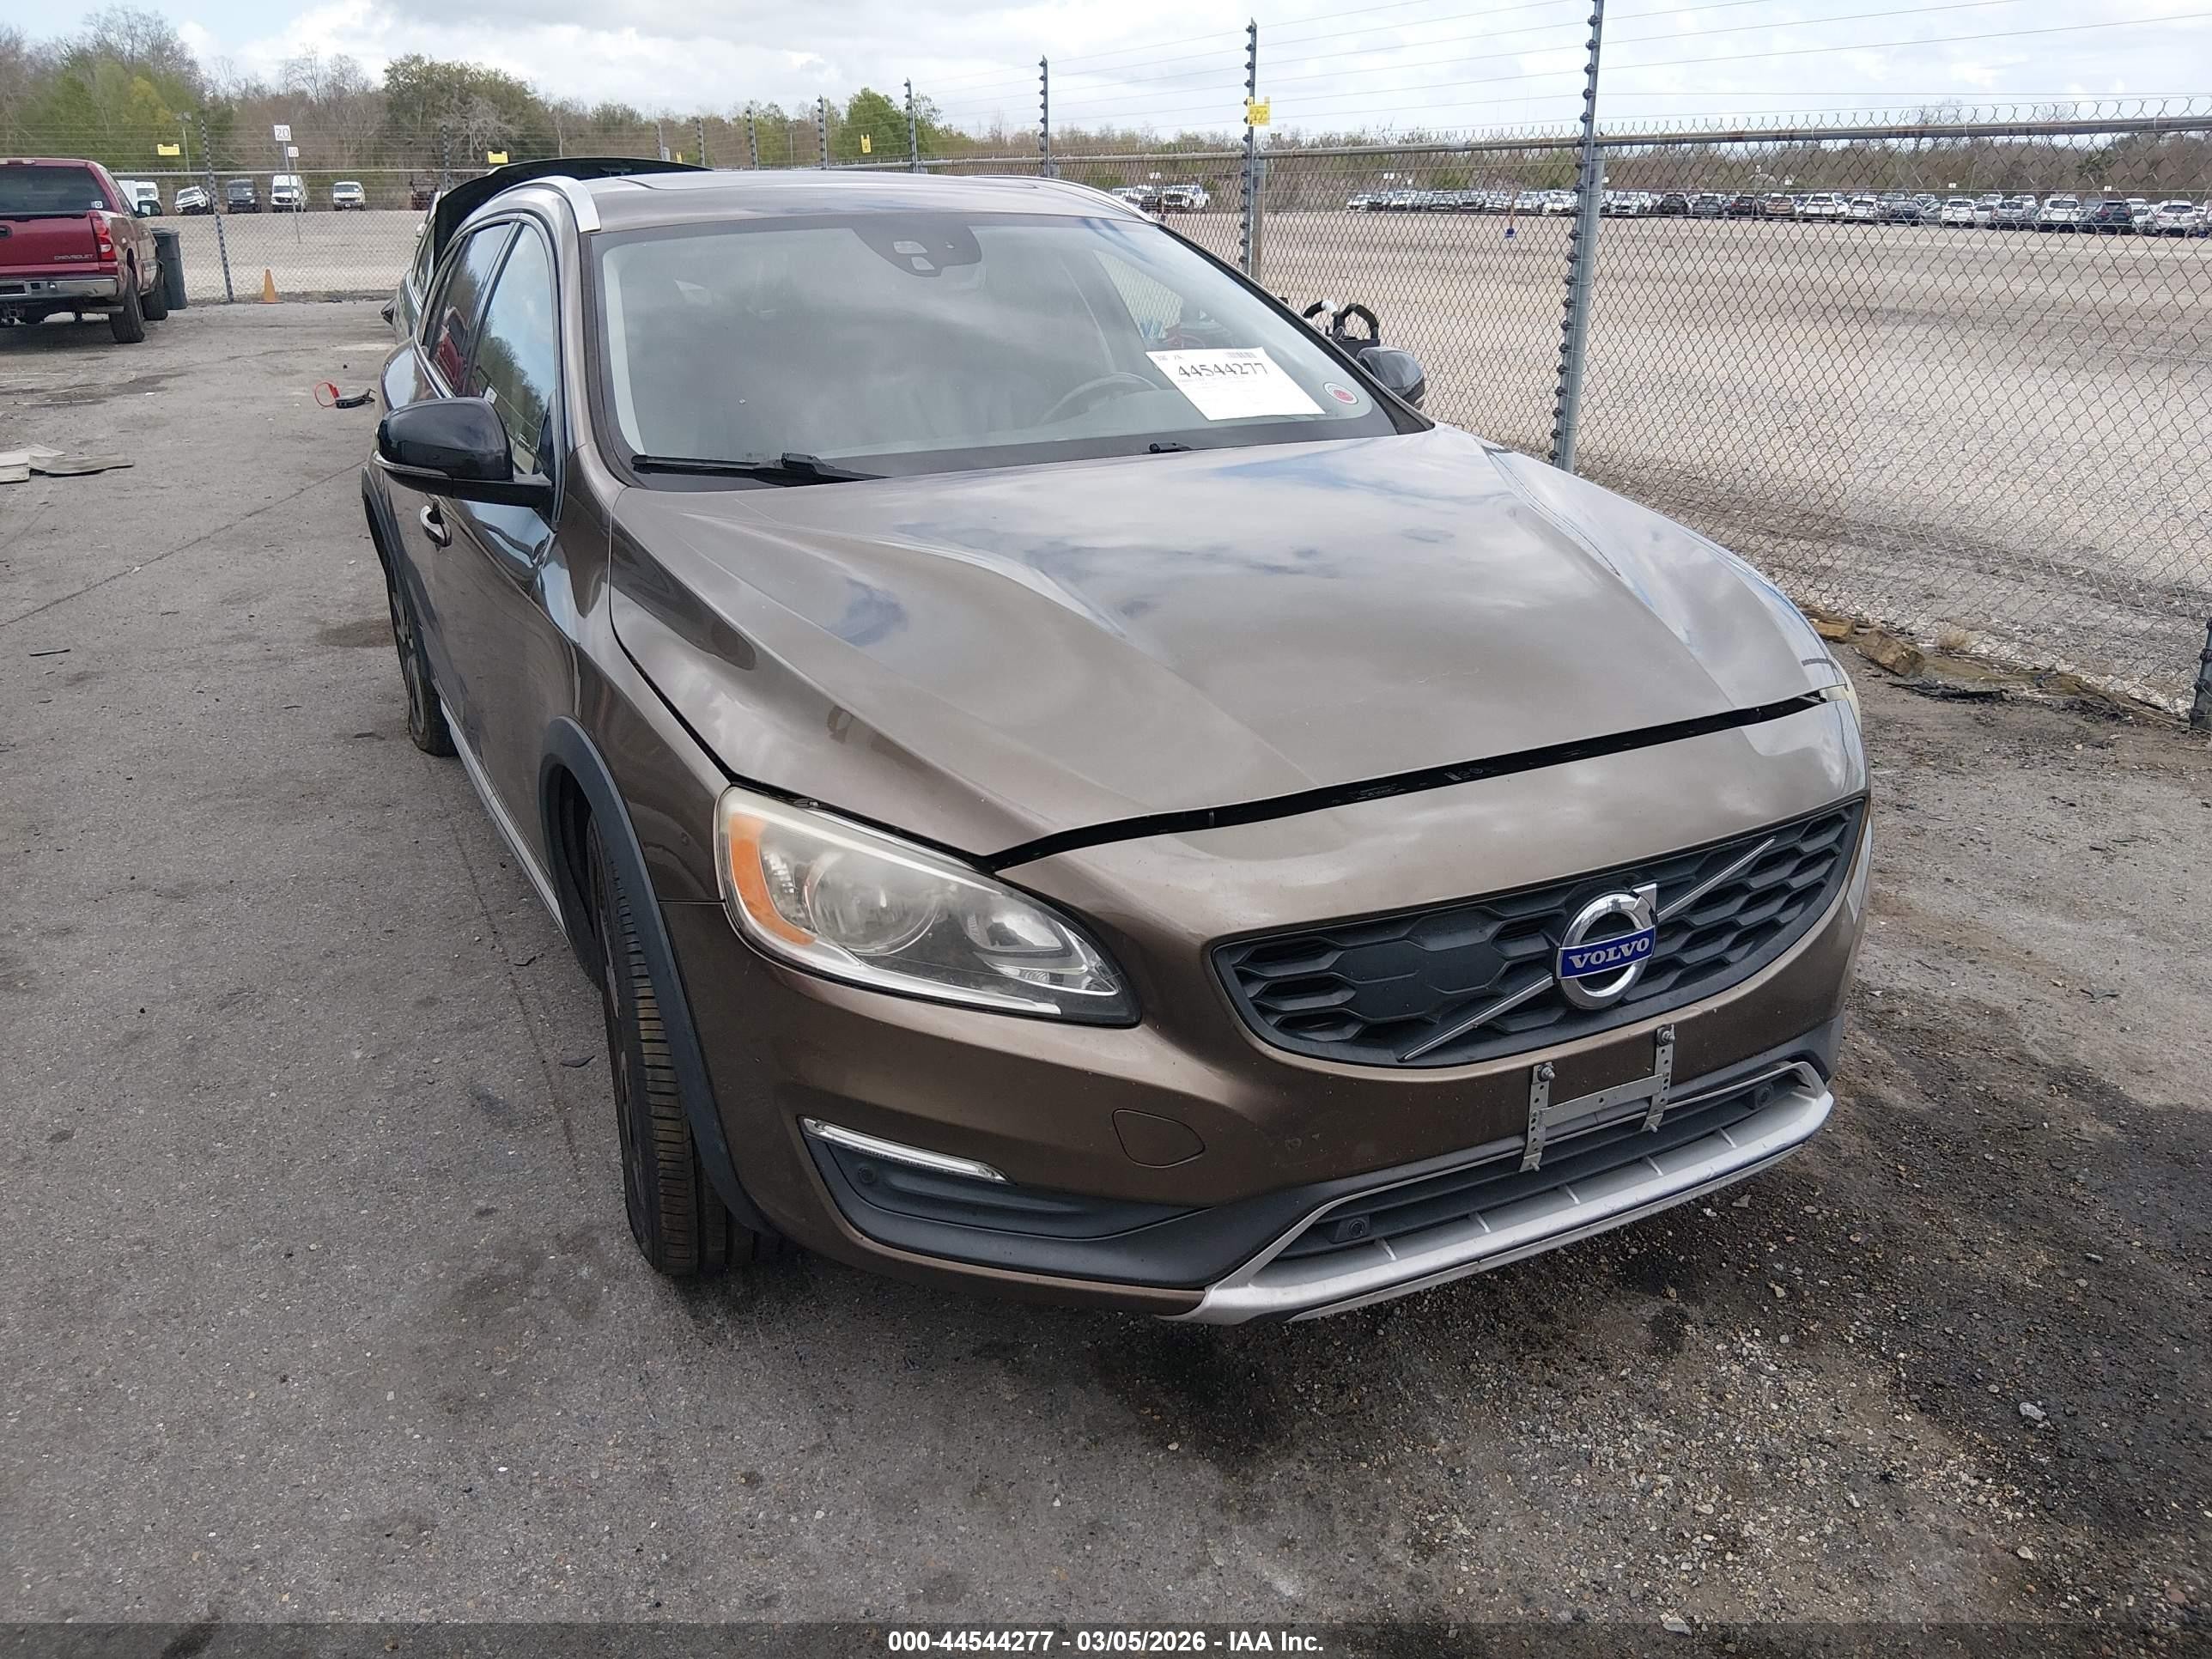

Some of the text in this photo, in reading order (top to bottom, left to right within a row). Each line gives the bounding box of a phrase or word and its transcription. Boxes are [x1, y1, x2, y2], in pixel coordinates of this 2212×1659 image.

[275, 128, 290, 138] 20
[1178, 362, 1270, 378] 44544277
[1569, 937, 1650, 969] VOLVO
